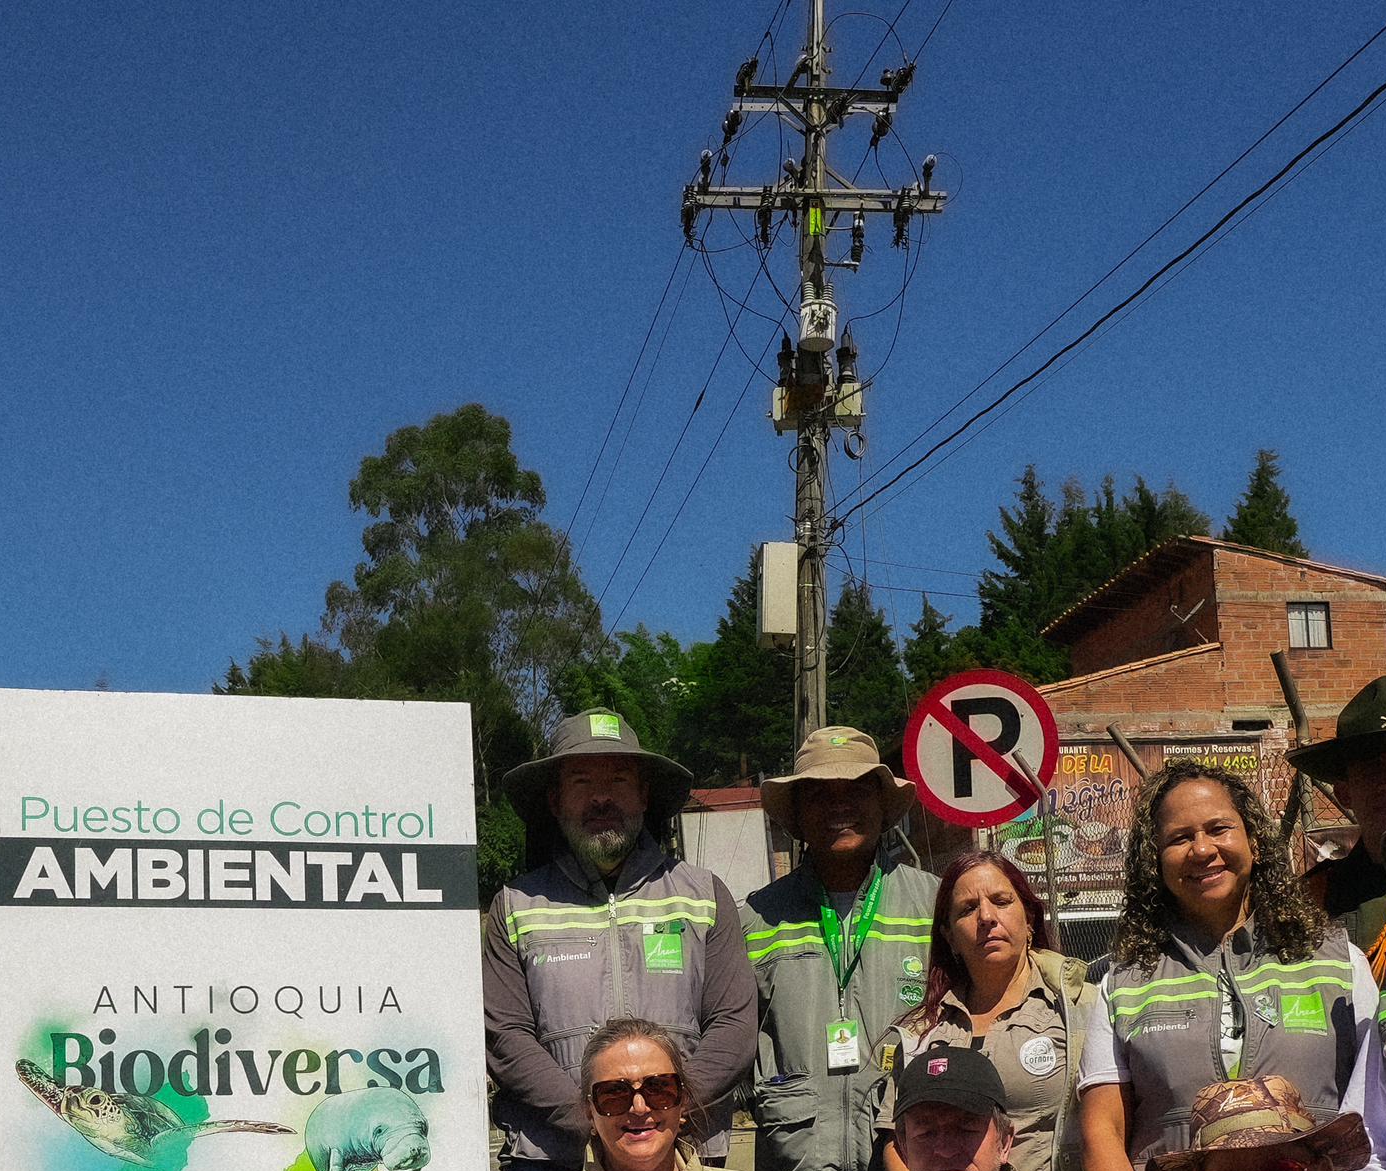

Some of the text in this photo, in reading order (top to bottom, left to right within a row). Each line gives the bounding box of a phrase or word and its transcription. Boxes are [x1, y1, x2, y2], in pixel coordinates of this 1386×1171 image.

[1163, 744, 1254, 755] Informes y Reservas:
[1063, 755, 1113, 774] DE LA
[20, 796, 435, 839] Puesto de Control
[13, 846, 444, 903] AMBIENTAL
[547, 952, 591, 963] Ambiental
[92, 984, 402, 1017] ANTIOQUIA
[1143, 1022, 1189, 1034] Ambiental
[50, 1028, 444, 1098] Biodiversa
[1024, 1053, 1054, 1065] Cornare
